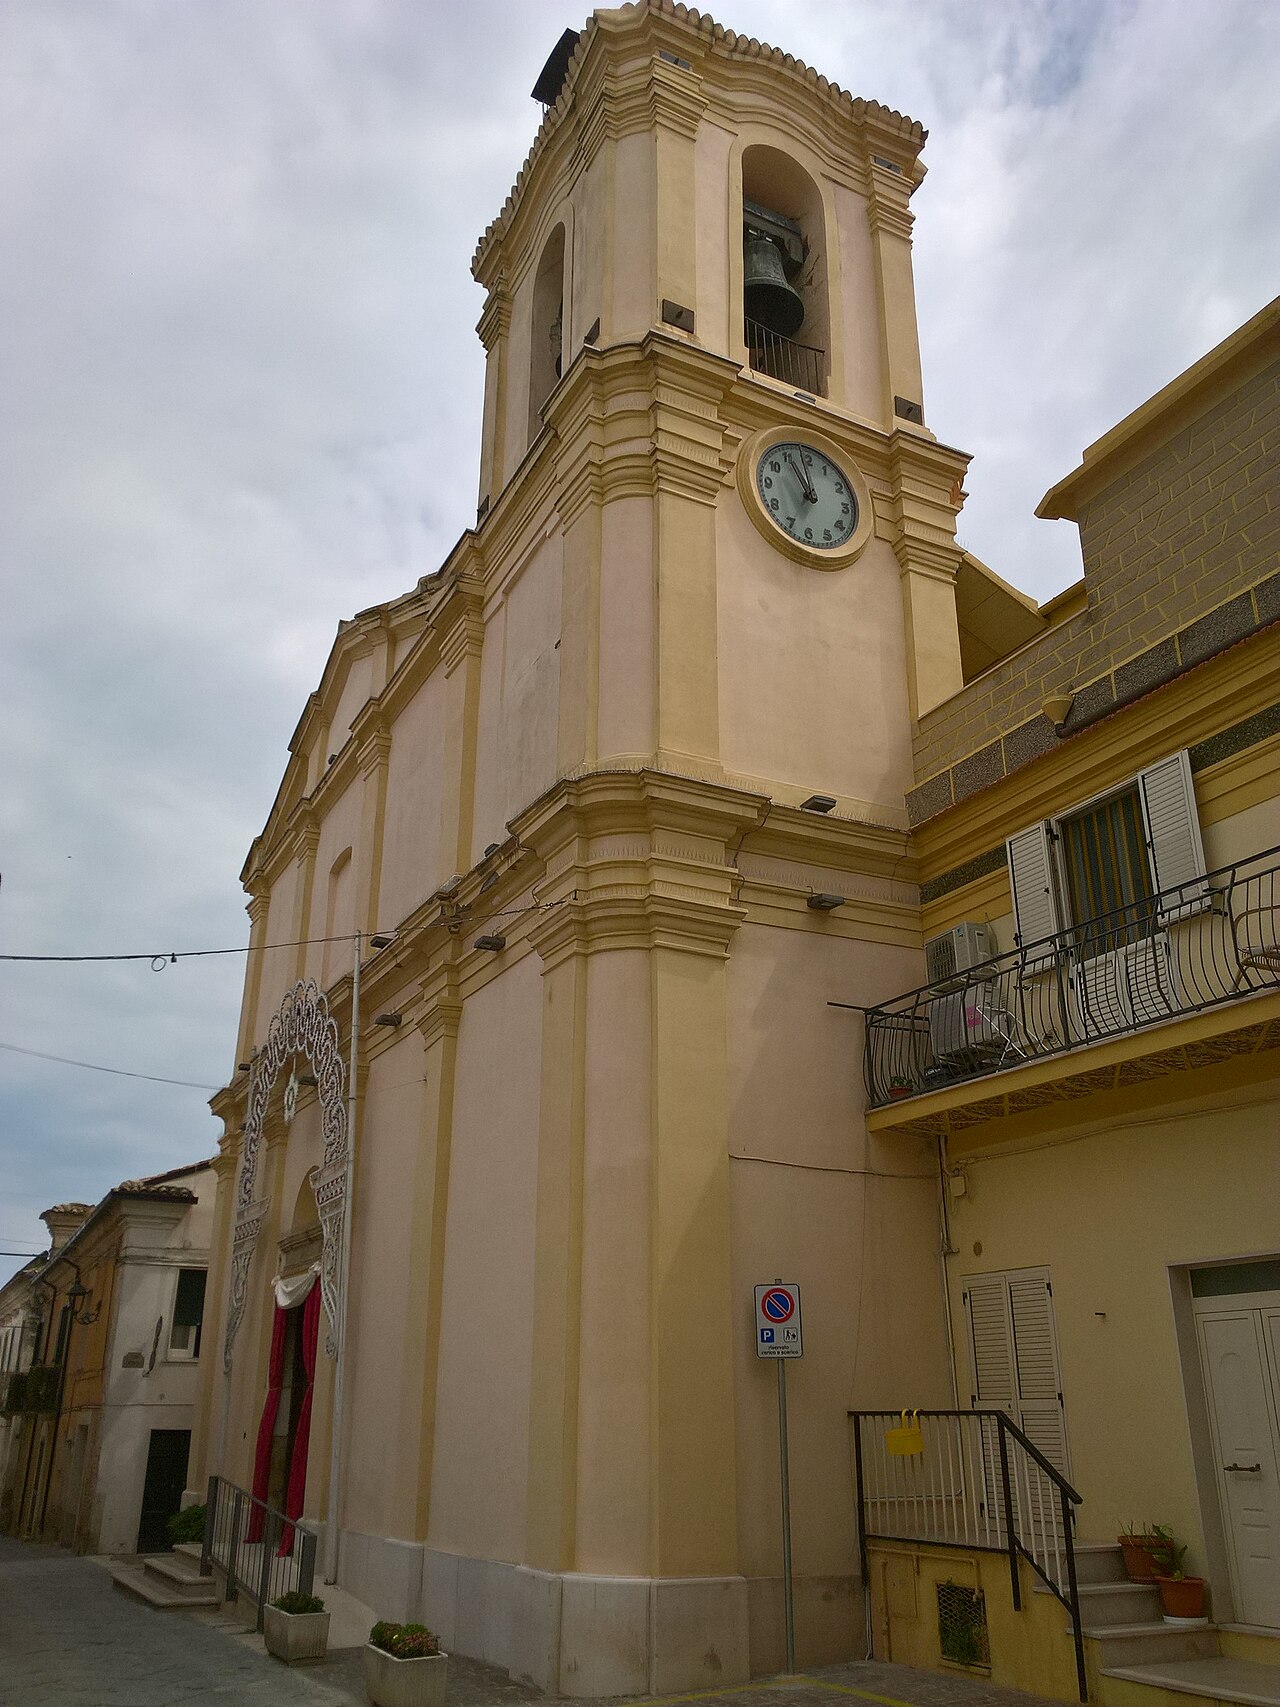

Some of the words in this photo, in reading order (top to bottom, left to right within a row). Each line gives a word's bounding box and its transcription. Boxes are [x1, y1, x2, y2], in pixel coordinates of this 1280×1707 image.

[769, 461, 780, 473] 10
[822, 465, 827, 476] 1
[764, 476, 773, 489] 9
[834, 481, 844, 495] 2
[770, 498, 779, 511] 8
[841, 502, 850, 514] 3
[786, 516, 796, 529] 7
[834, 520, 846, 532] 4
[804, 527, 813, 540] 6
[823, 528, 832, 541] 5
[764, 1330, 771, 1341] P
